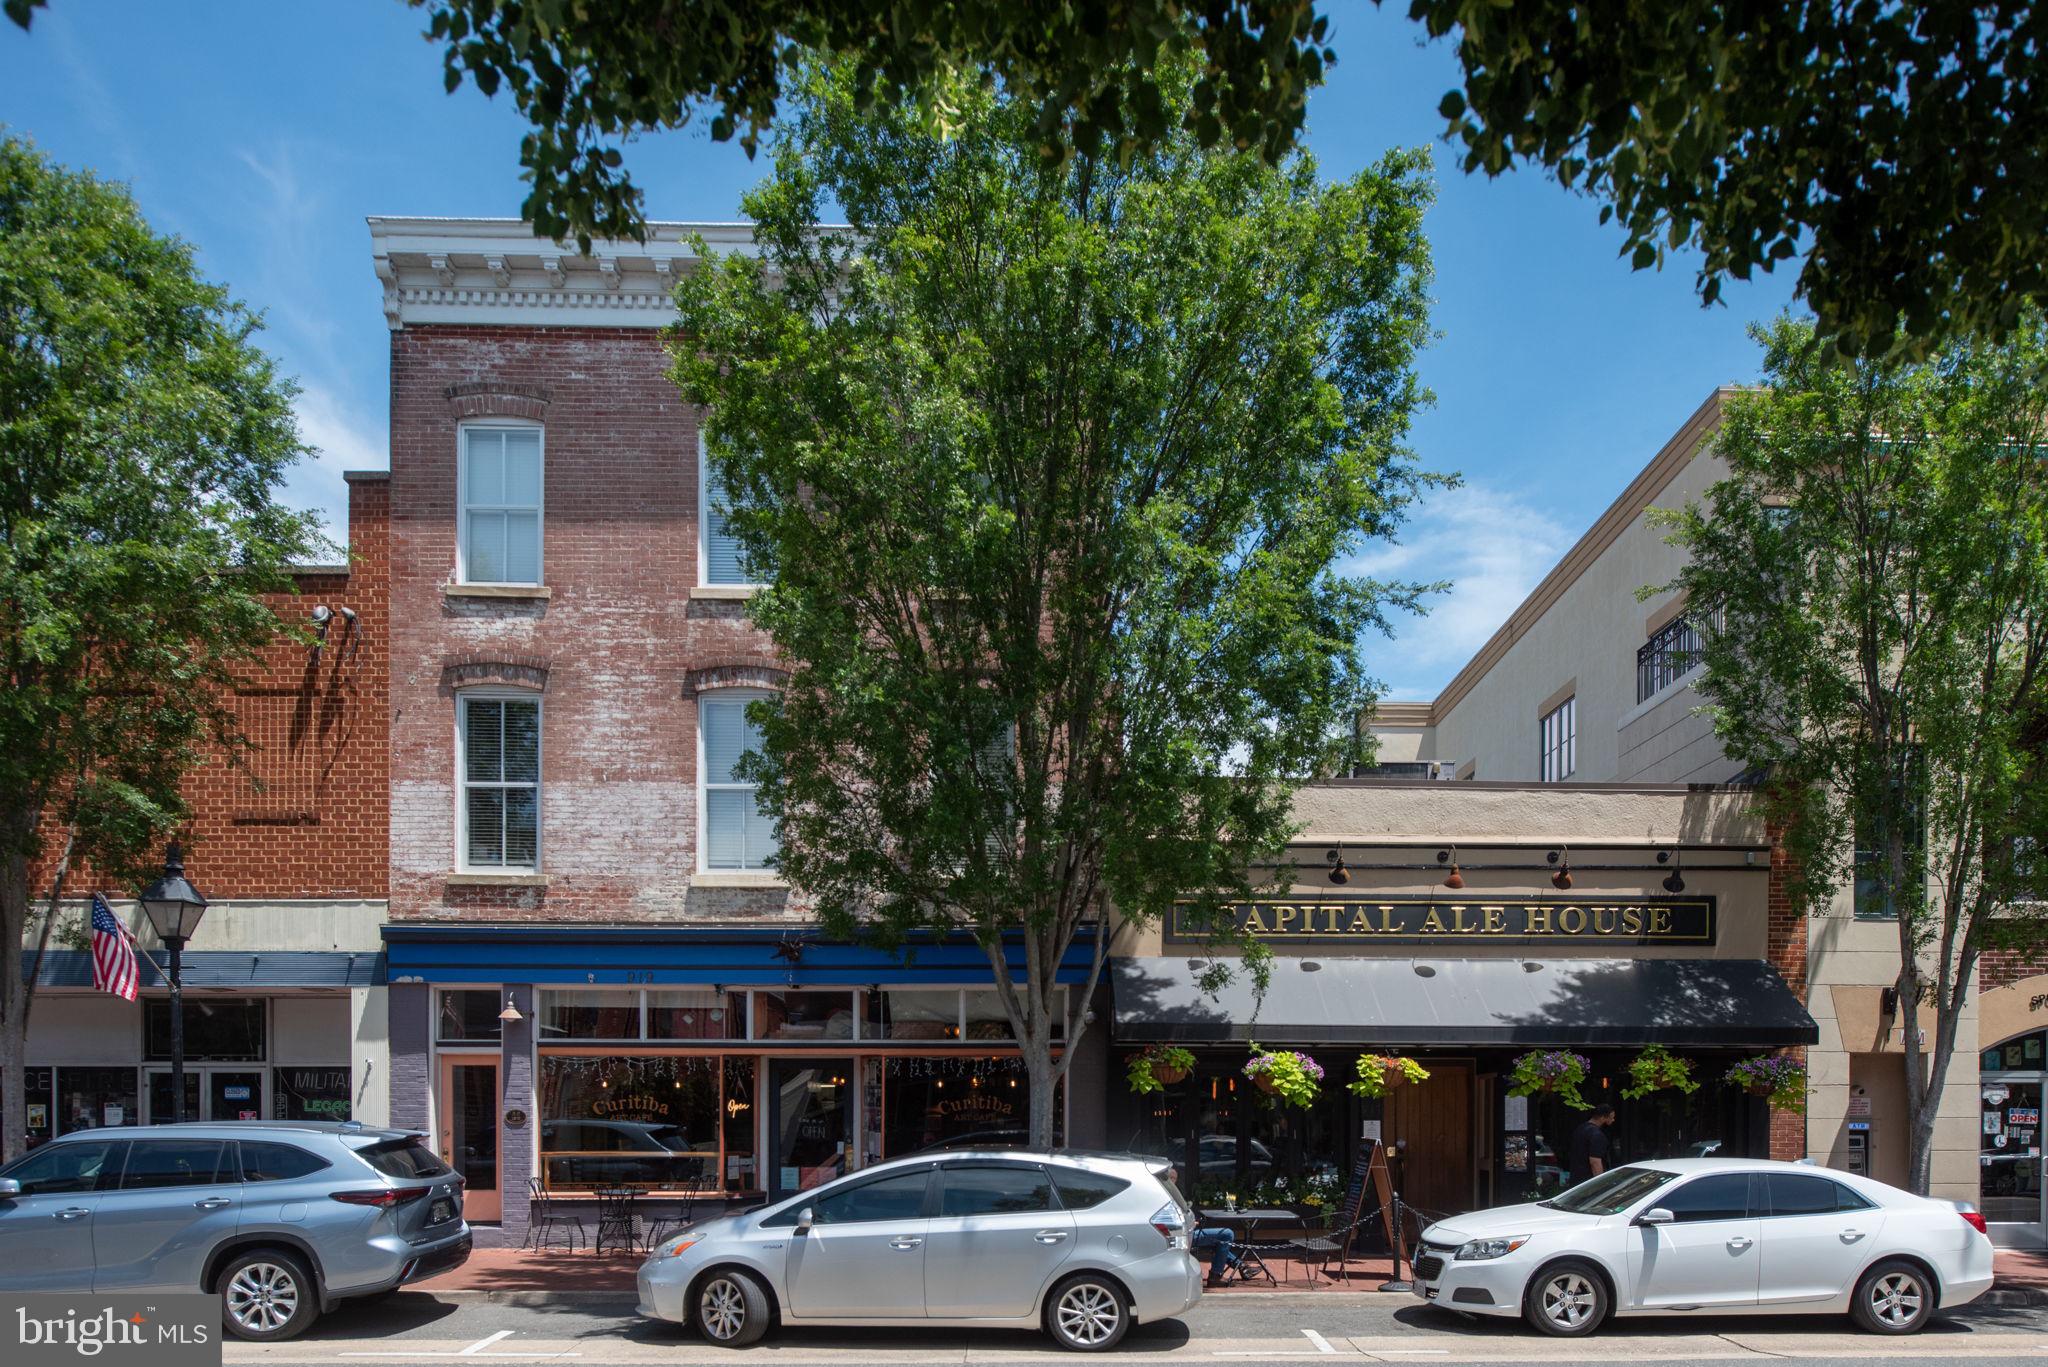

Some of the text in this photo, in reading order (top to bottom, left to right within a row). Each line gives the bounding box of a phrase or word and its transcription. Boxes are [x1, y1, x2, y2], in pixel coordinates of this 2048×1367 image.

[1213, 905, 1673, 933] CAPITAL ALE HOUSE
[592, 1093, 670, 1116] Curitiba
[727, 1099, 750, 1118] Open
[938, 1095, 1012, 1115] Curitiba
[1851, 1122, 1867, 1130] ATM
[2009, 1114, 2038, 1123] OPEN
